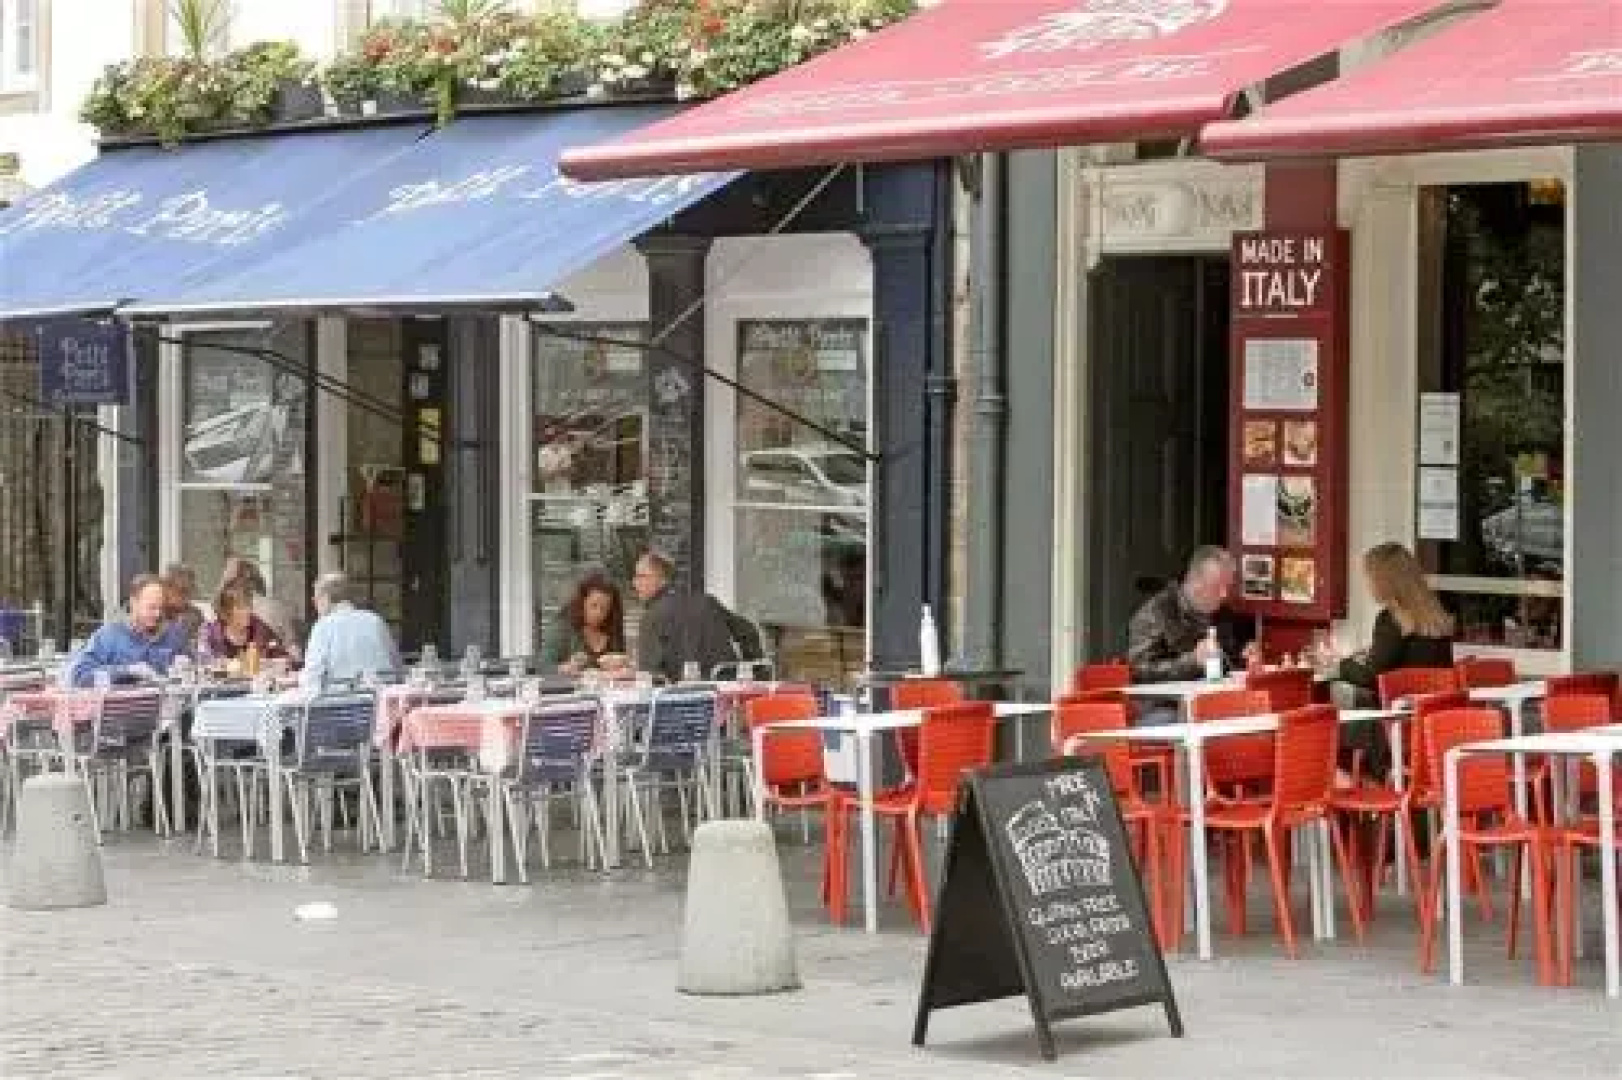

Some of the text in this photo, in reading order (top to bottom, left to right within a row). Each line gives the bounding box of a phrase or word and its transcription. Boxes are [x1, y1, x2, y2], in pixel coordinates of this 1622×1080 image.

[1242, 237, 1324, 263] MADE IN
[1240, 269, 1321, 308] ITALY
